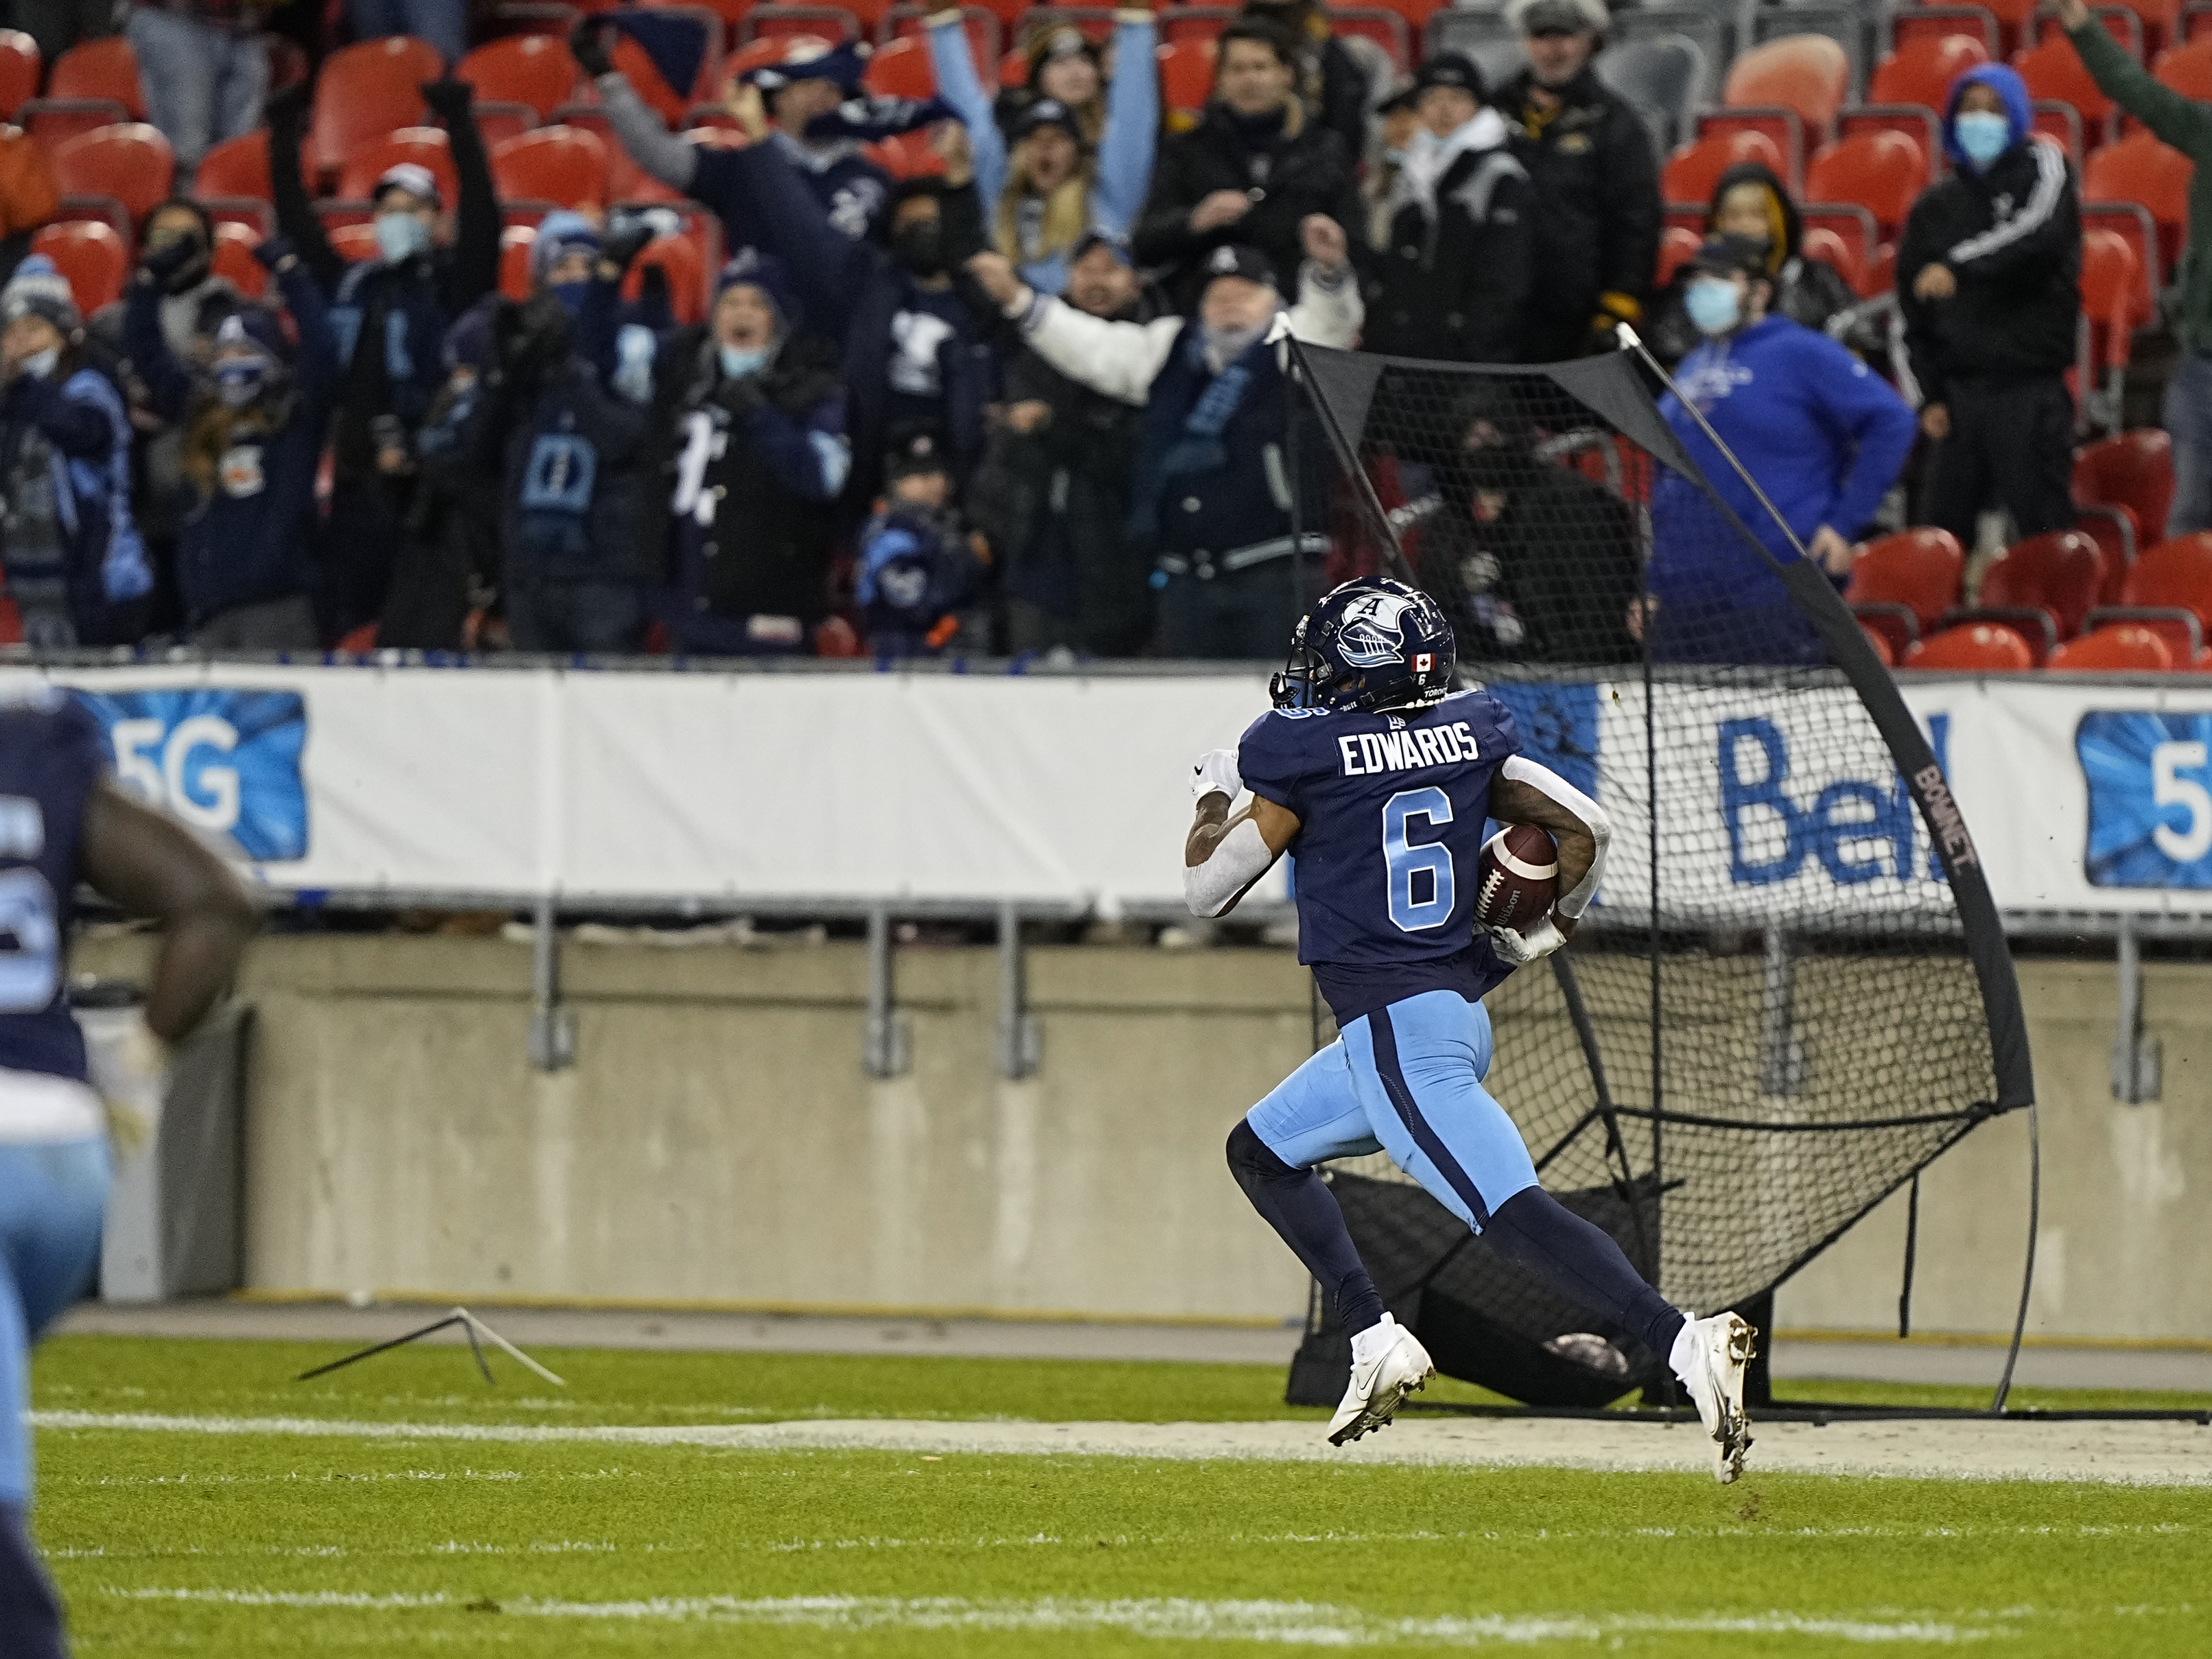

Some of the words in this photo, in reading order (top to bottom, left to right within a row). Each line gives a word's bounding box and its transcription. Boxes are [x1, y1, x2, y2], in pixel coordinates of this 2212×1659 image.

[1357, 598, 1385, 617] A
[1418, 674, 1426, 685] 6
[1424, 687, 1448, 698] TORONT
[1339, 701, 1358, 711] hutt
[1338, 721, 1479, 776] EDWARDS
[112, 714, 241, 830] 5G
[1382, 786, 1455, 932] 6
[1494, 889, 1522, 925] Wilson
